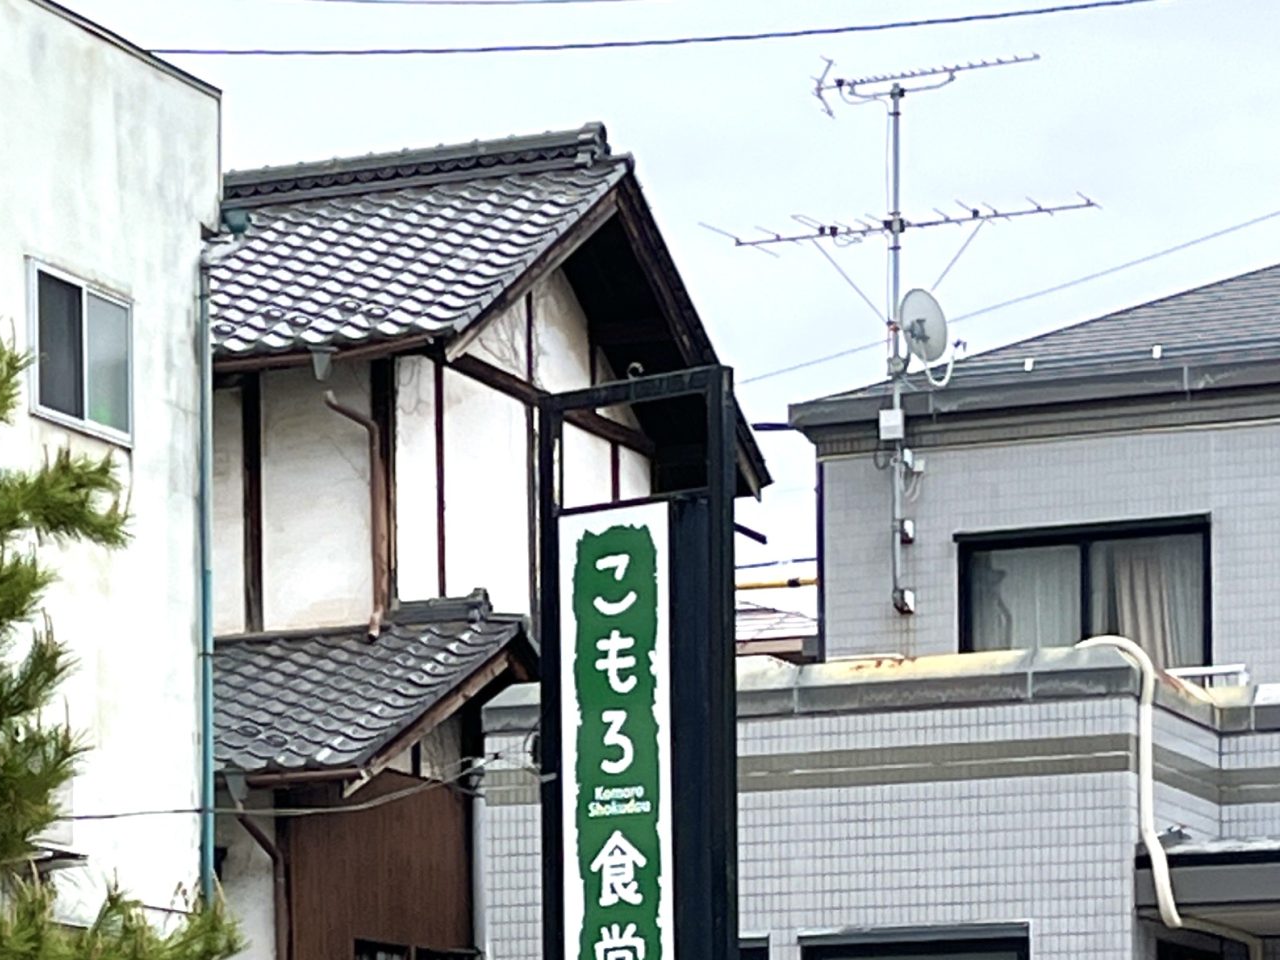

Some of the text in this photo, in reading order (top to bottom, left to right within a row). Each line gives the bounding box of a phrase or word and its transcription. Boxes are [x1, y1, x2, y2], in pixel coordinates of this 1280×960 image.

[593, 553, 638, 774] こもろ
[595, 785, 644, 801] Komoro
